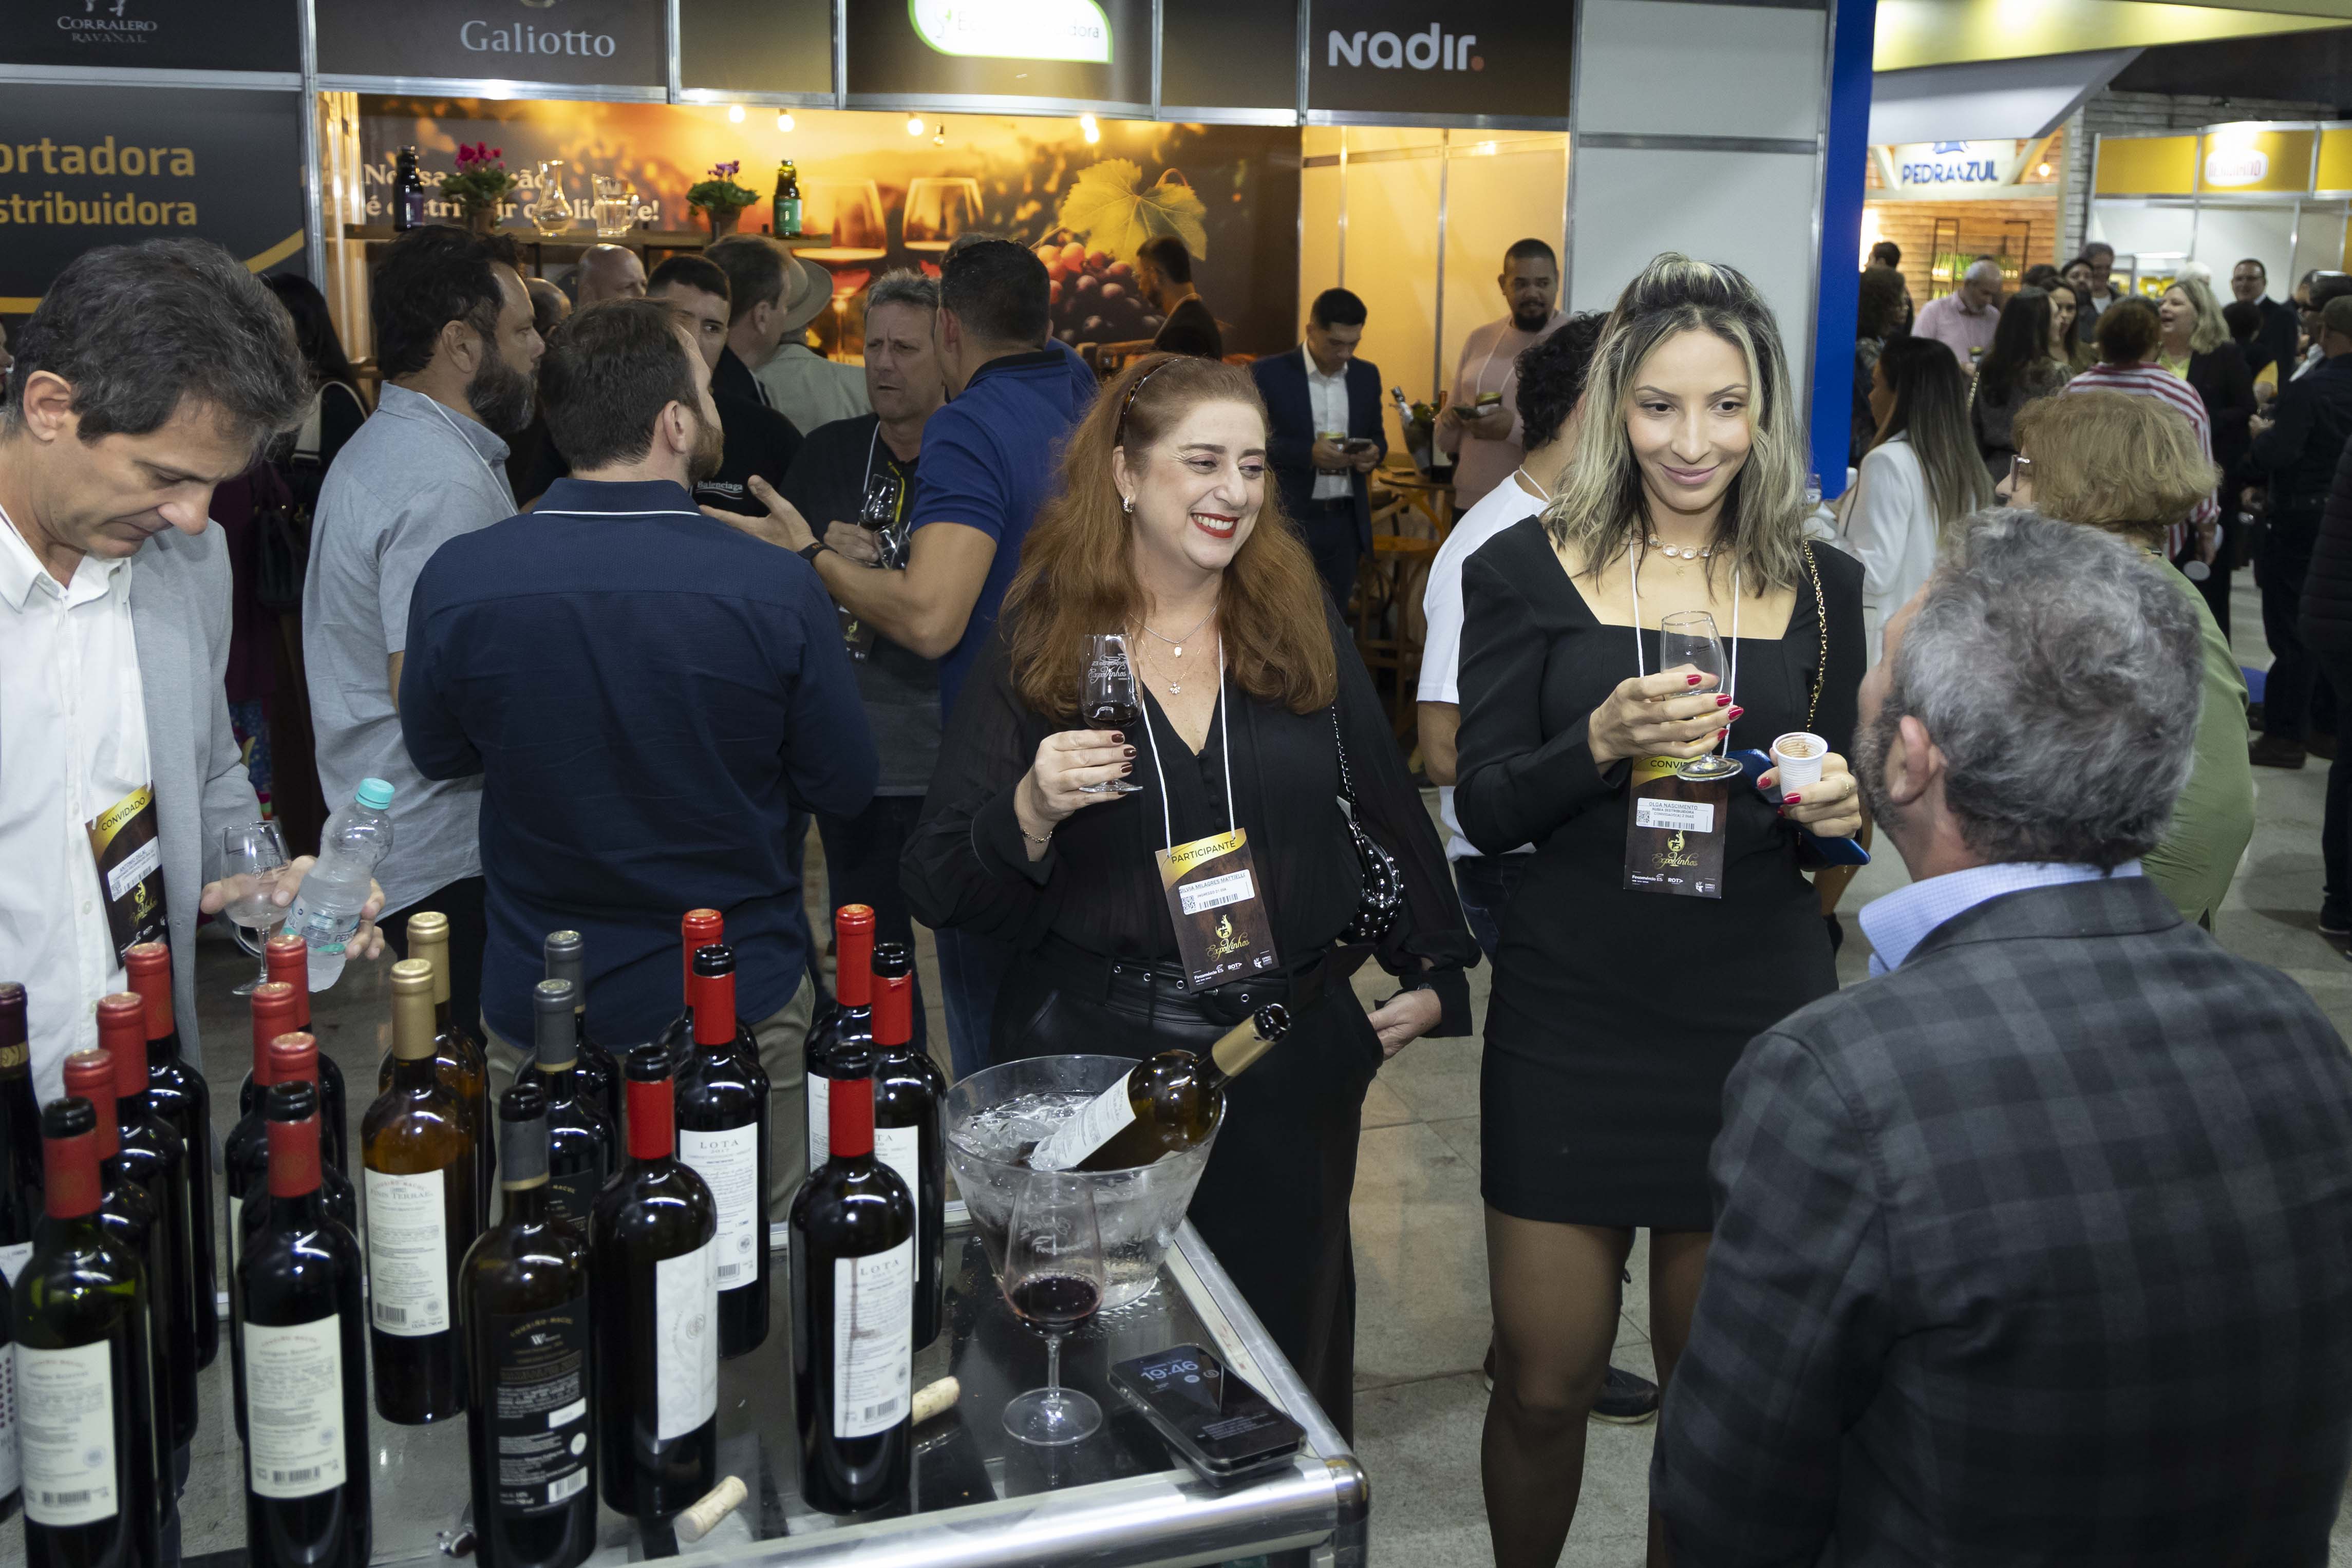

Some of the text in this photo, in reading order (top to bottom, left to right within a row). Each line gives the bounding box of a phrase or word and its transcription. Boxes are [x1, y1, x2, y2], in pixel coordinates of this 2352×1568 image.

[57, 16, 157, 31] CORRALERO
[460, 20, 616, 58] Galiotto
[364, 164, 447, 186] Nosa
[698, 481, 743, 491] Balenciaga
[1650, 760, 1690, 768] CONVI
[102, 797, 145, 830] CONVIDADO
[1172, 840, 1236, 863] PARTICIPANTE
[1652, 852, 1699, 869] ExpoVinhos
[1179, 885, 1195, 894] SILVIA
[1196, 879, 1220, 889] MILAGRES
[1207, 932, 1250, 961] ExpoVinhos
[700, 1139, 739, 1149] LOTA
[860, 1260, 899, 1276] LOTA
[1140, 1361, 1199, 1381] 19:46
